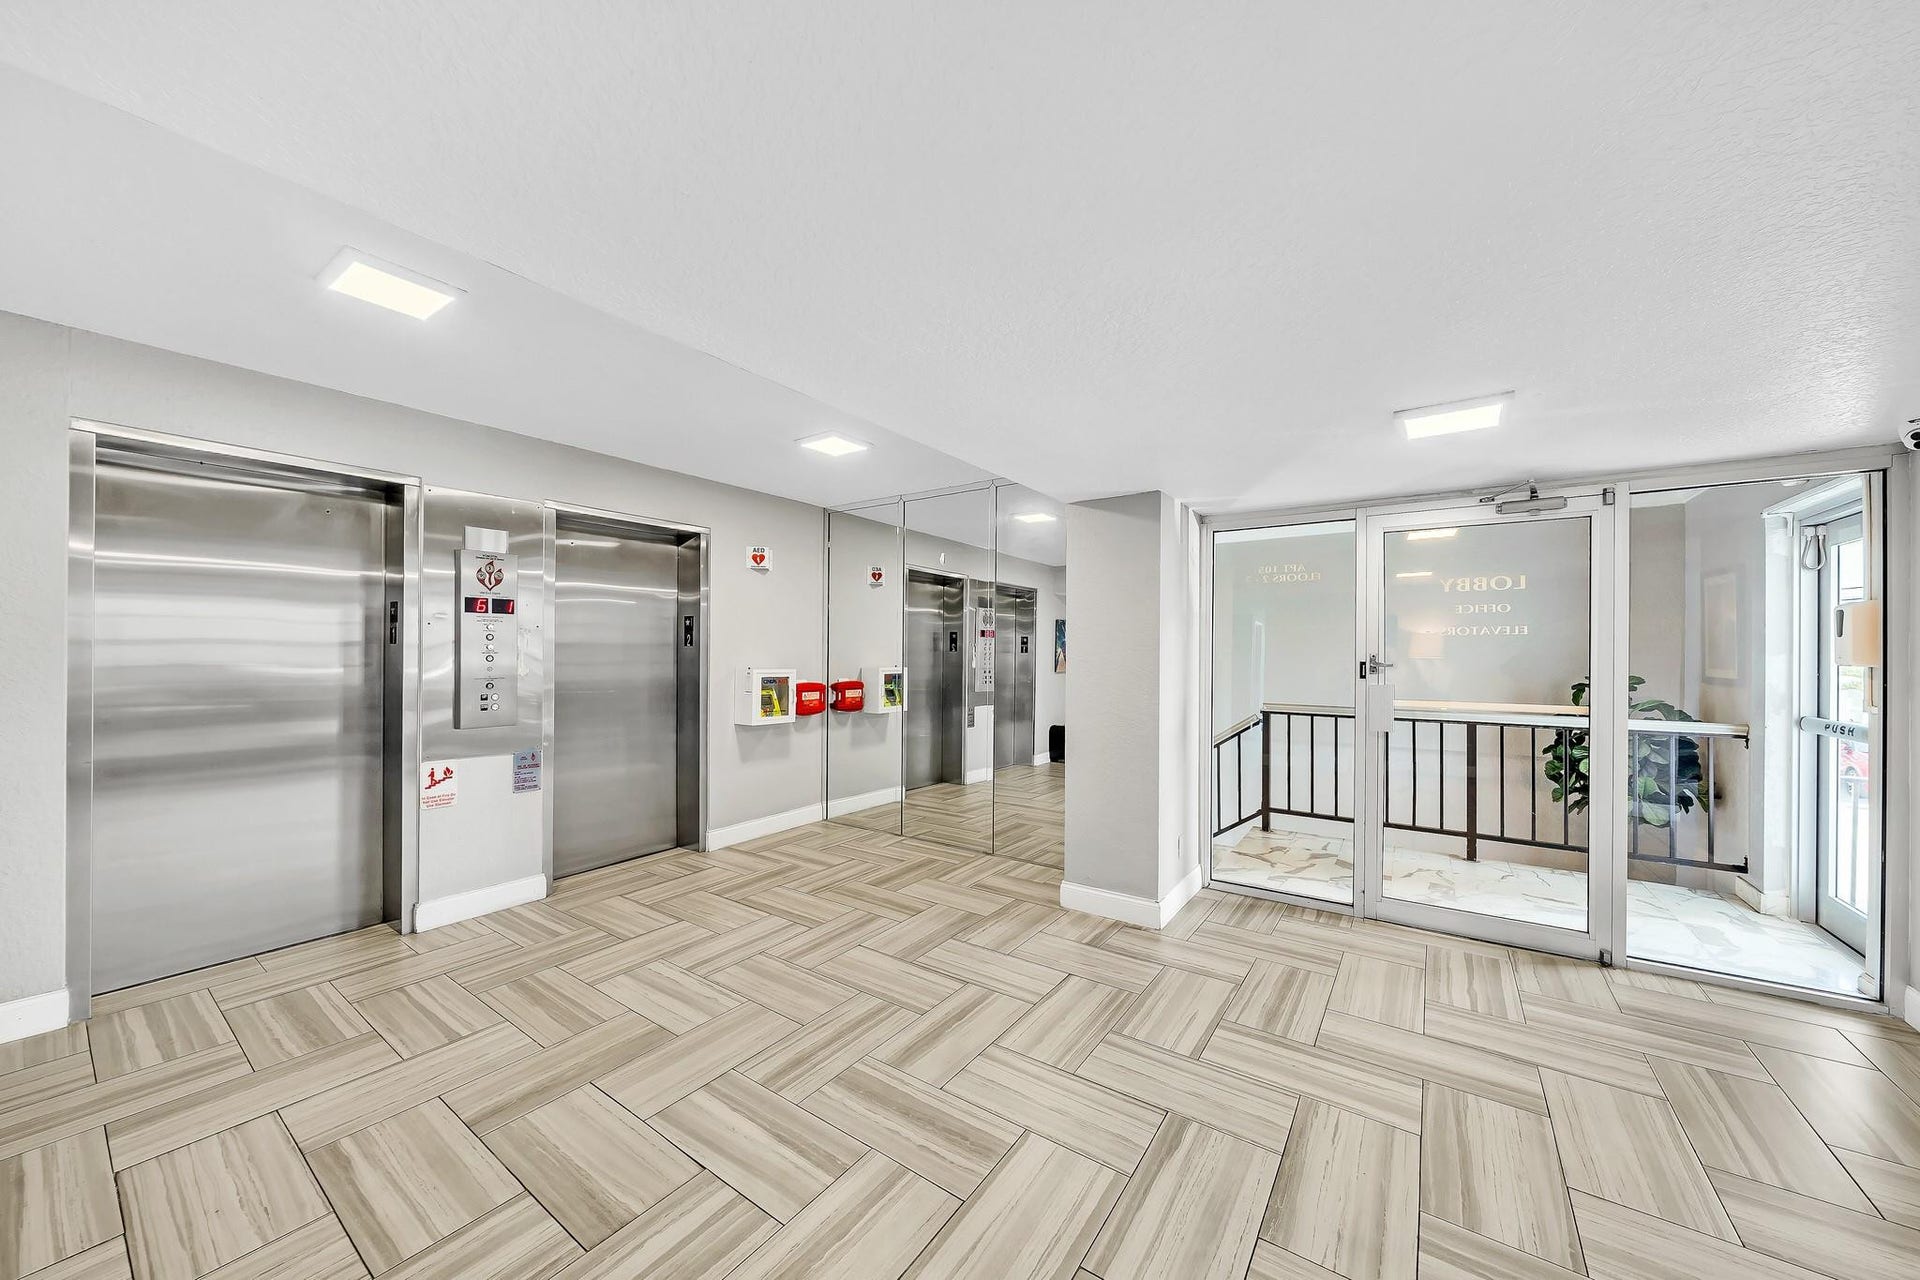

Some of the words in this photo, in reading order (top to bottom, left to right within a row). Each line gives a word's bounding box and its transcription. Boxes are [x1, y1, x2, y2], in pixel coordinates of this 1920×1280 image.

[476, 599, 487, 612] 6
[686, 634, 691, 647] 2
[1824, 723, 1856, 737] PUSH
